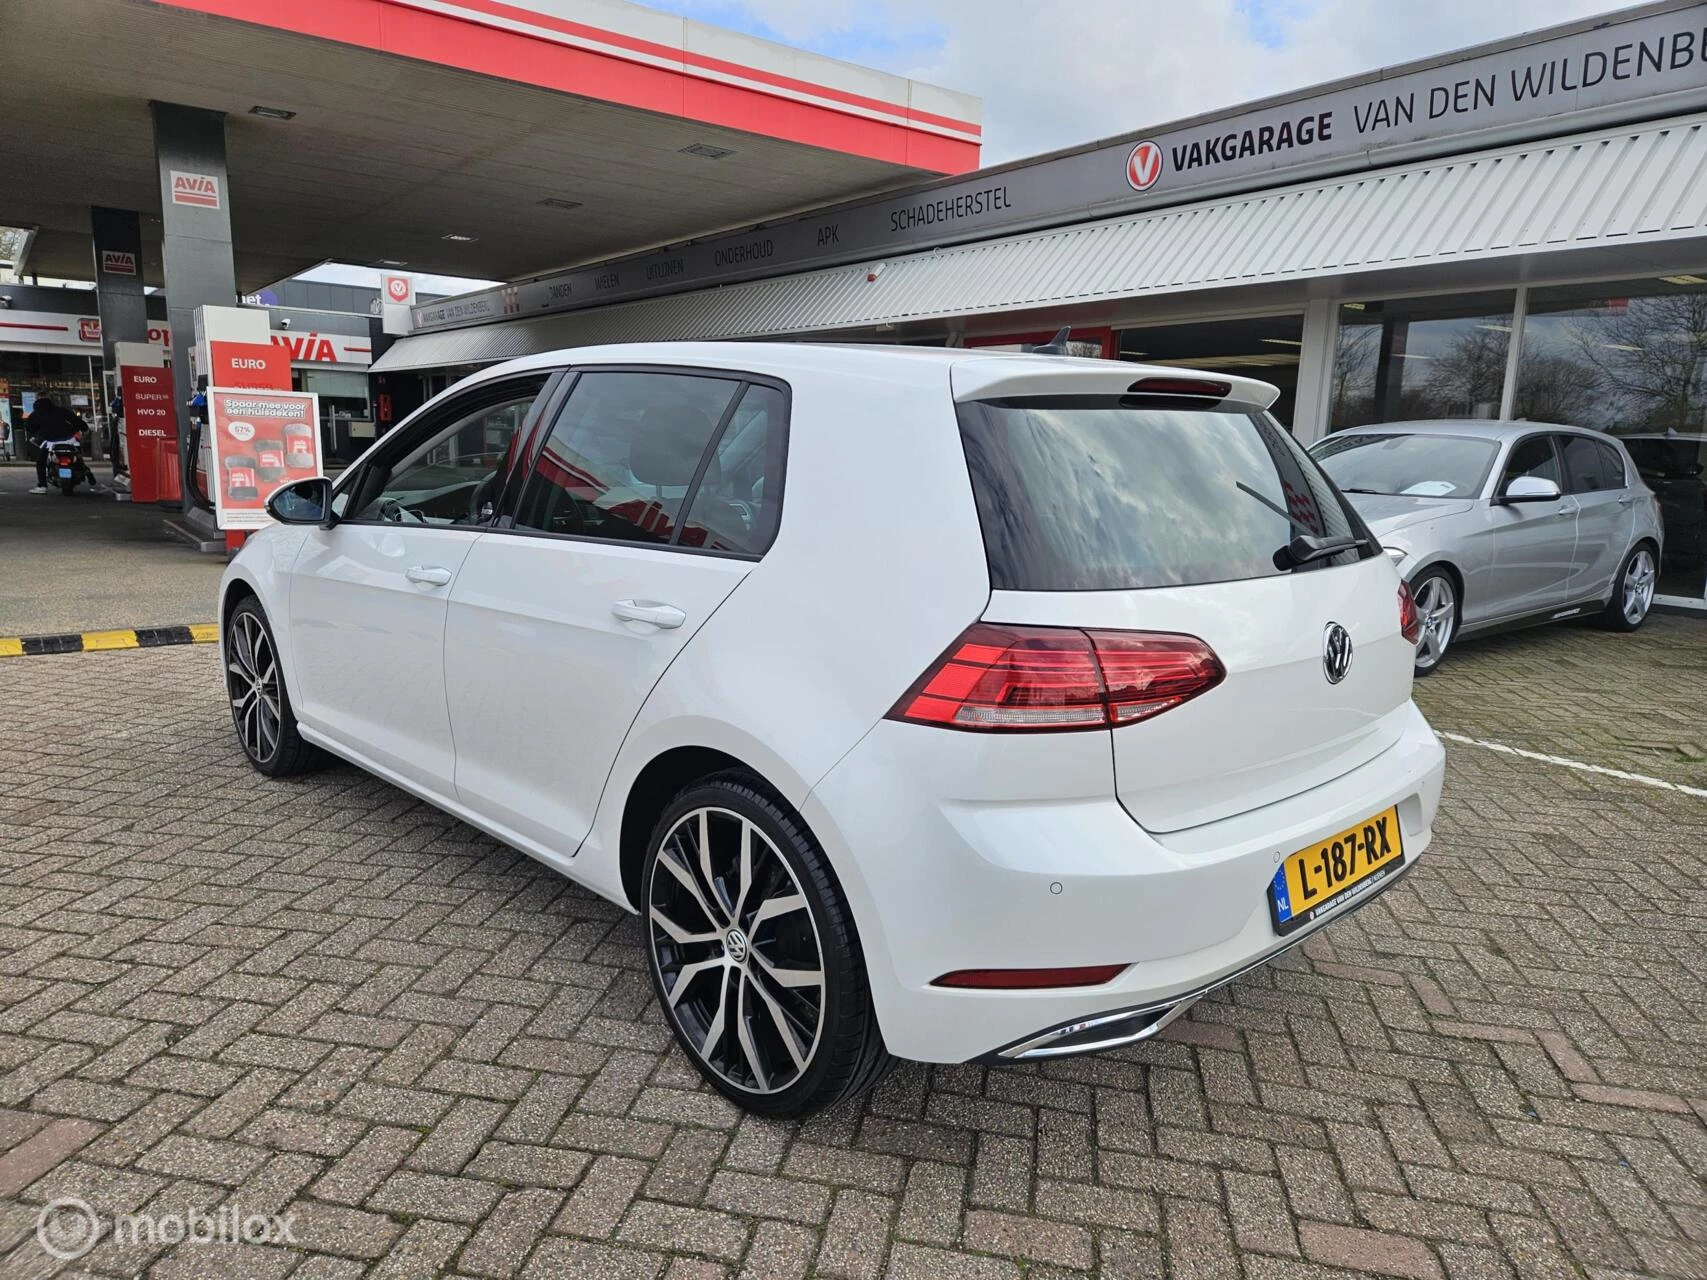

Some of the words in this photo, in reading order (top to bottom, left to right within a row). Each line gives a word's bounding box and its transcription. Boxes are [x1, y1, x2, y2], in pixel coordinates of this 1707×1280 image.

[1172, 111, 1333, 172] VAKGARAGE
[1353, 92, 1414, 134] VAN
[1428, 74, 1497, 120] DEN
[714, 239, 774, 266] ONDERHOUD
[817, 224, 839, 247] APK
[890, 186, 1012, 232] SCHADEHERSTEL
[231, 358, 266, 370] EURO
[133, 375, 157, 384] EURO
[135, 393, 162, 401] SUPER
[225, 400, 257, 411] Spaar
[137, 408, 155, 416] HVO
[138, 429, 167, 437] DIESEL
[1298, 816, 1392, 900] L-187-RX
[1277, 897, 1290, 913] NL
